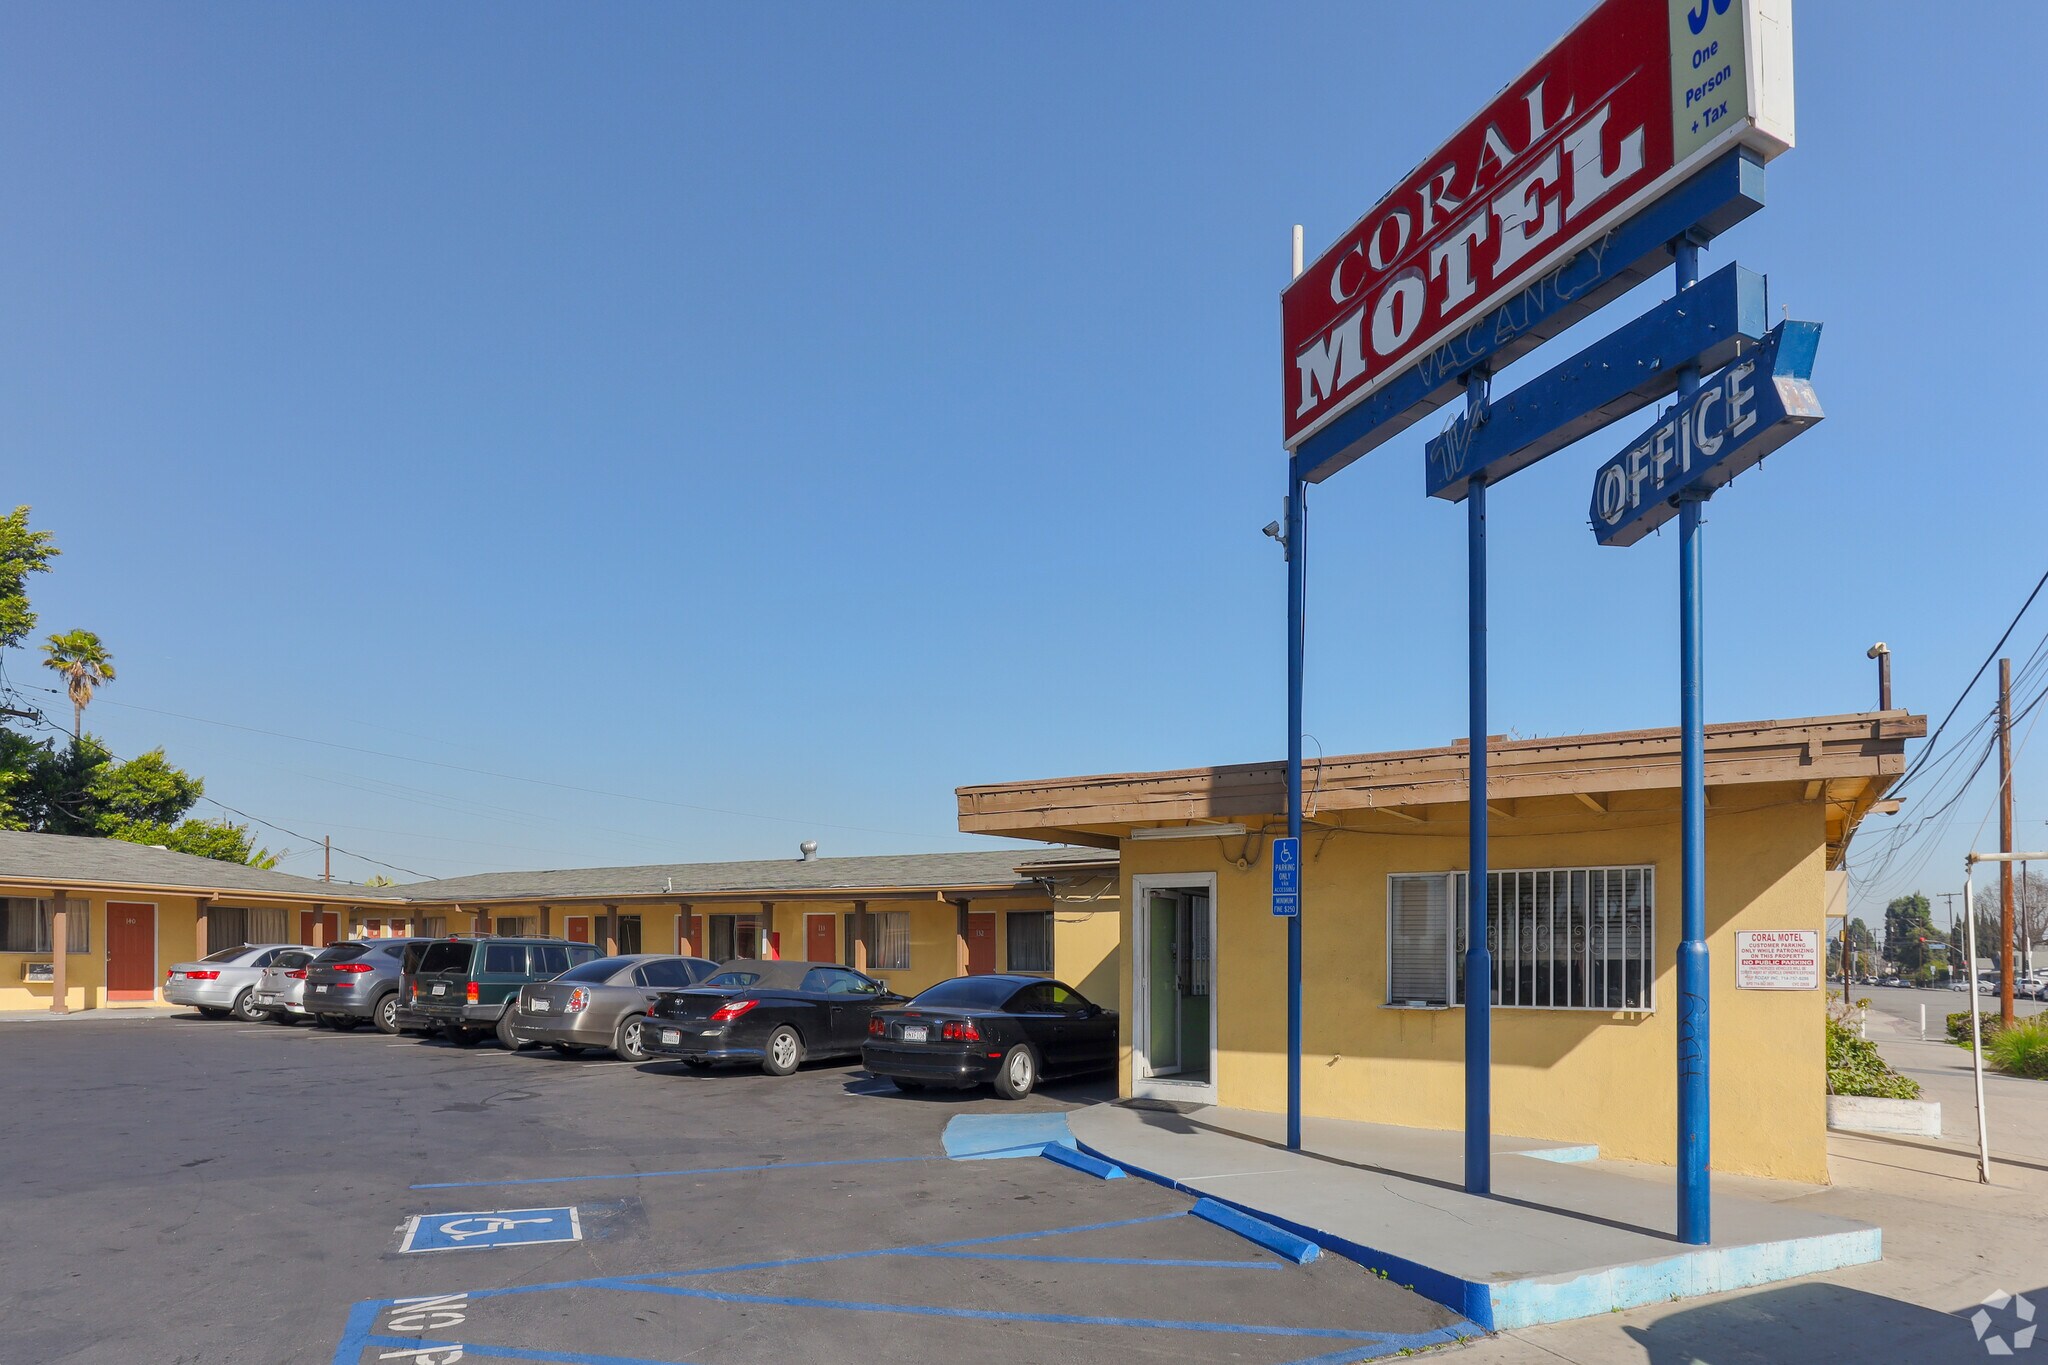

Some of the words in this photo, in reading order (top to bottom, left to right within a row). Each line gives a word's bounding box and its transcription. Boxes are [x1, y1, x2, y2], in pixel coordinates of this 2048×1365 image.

[1692, 40, 1719, 70] One
[1685, 64, 1731, 108] Person
[1702, 100, 1728, 127] Tax
[1330, 77, 1575, 305] CORAL
[1296, 102, 1645, 420] MOTEL
[1417, 229, 1615, 387] VACANCY
[1597, 359, 1757, 526] OFFICE
[1275, 863, 1295, 872] PARKING
[1279, 872, 1291, 880] ONLY
[387, 1293, 468, 1331] NO
